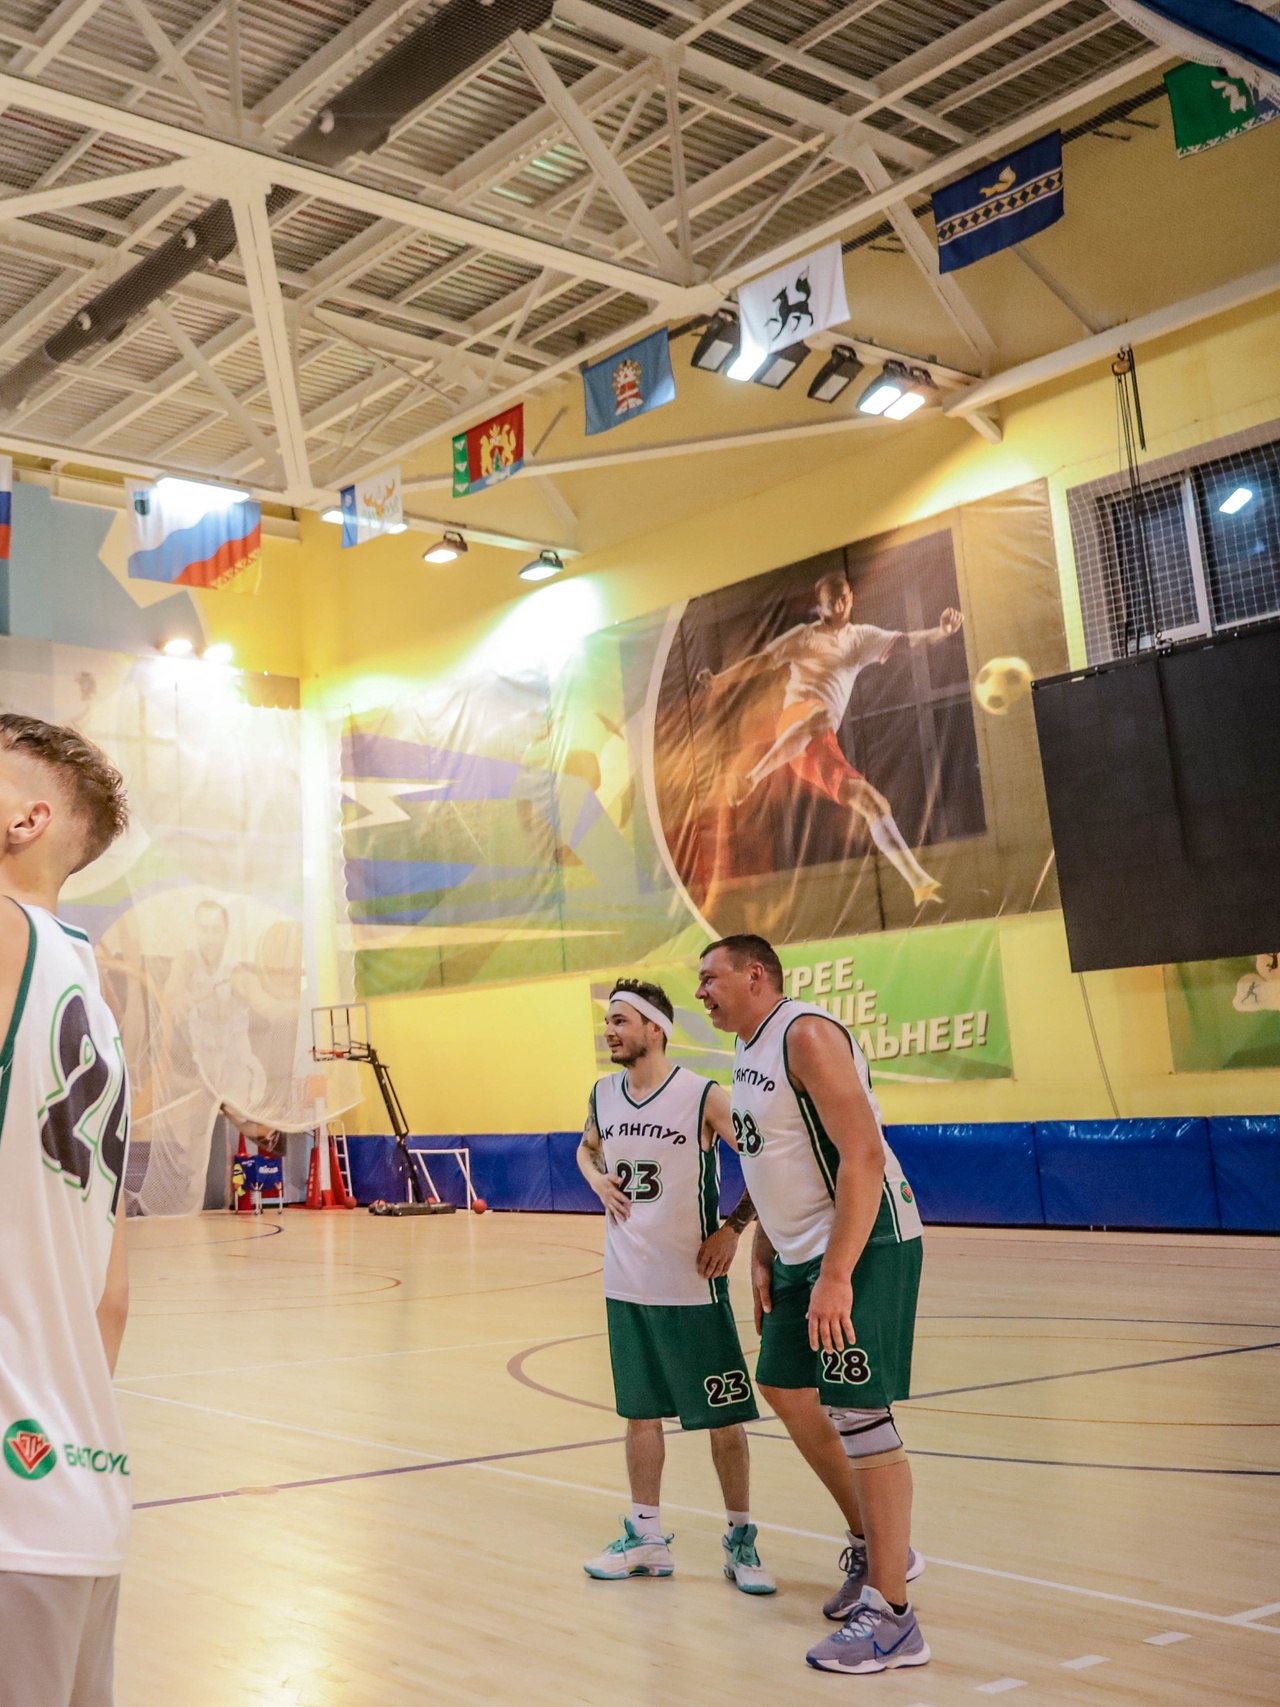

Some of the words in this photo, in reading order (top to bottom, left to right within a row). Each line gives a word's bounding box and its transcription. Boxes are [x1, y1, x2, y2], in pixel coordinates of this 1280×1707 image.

[618, 1122, 687, 1145] ЯНГПУР
[615, 1159, 664, 1204] 23
[821, 1348, 872, 1385] 28
[703, 1370, 751, 1408] 23
